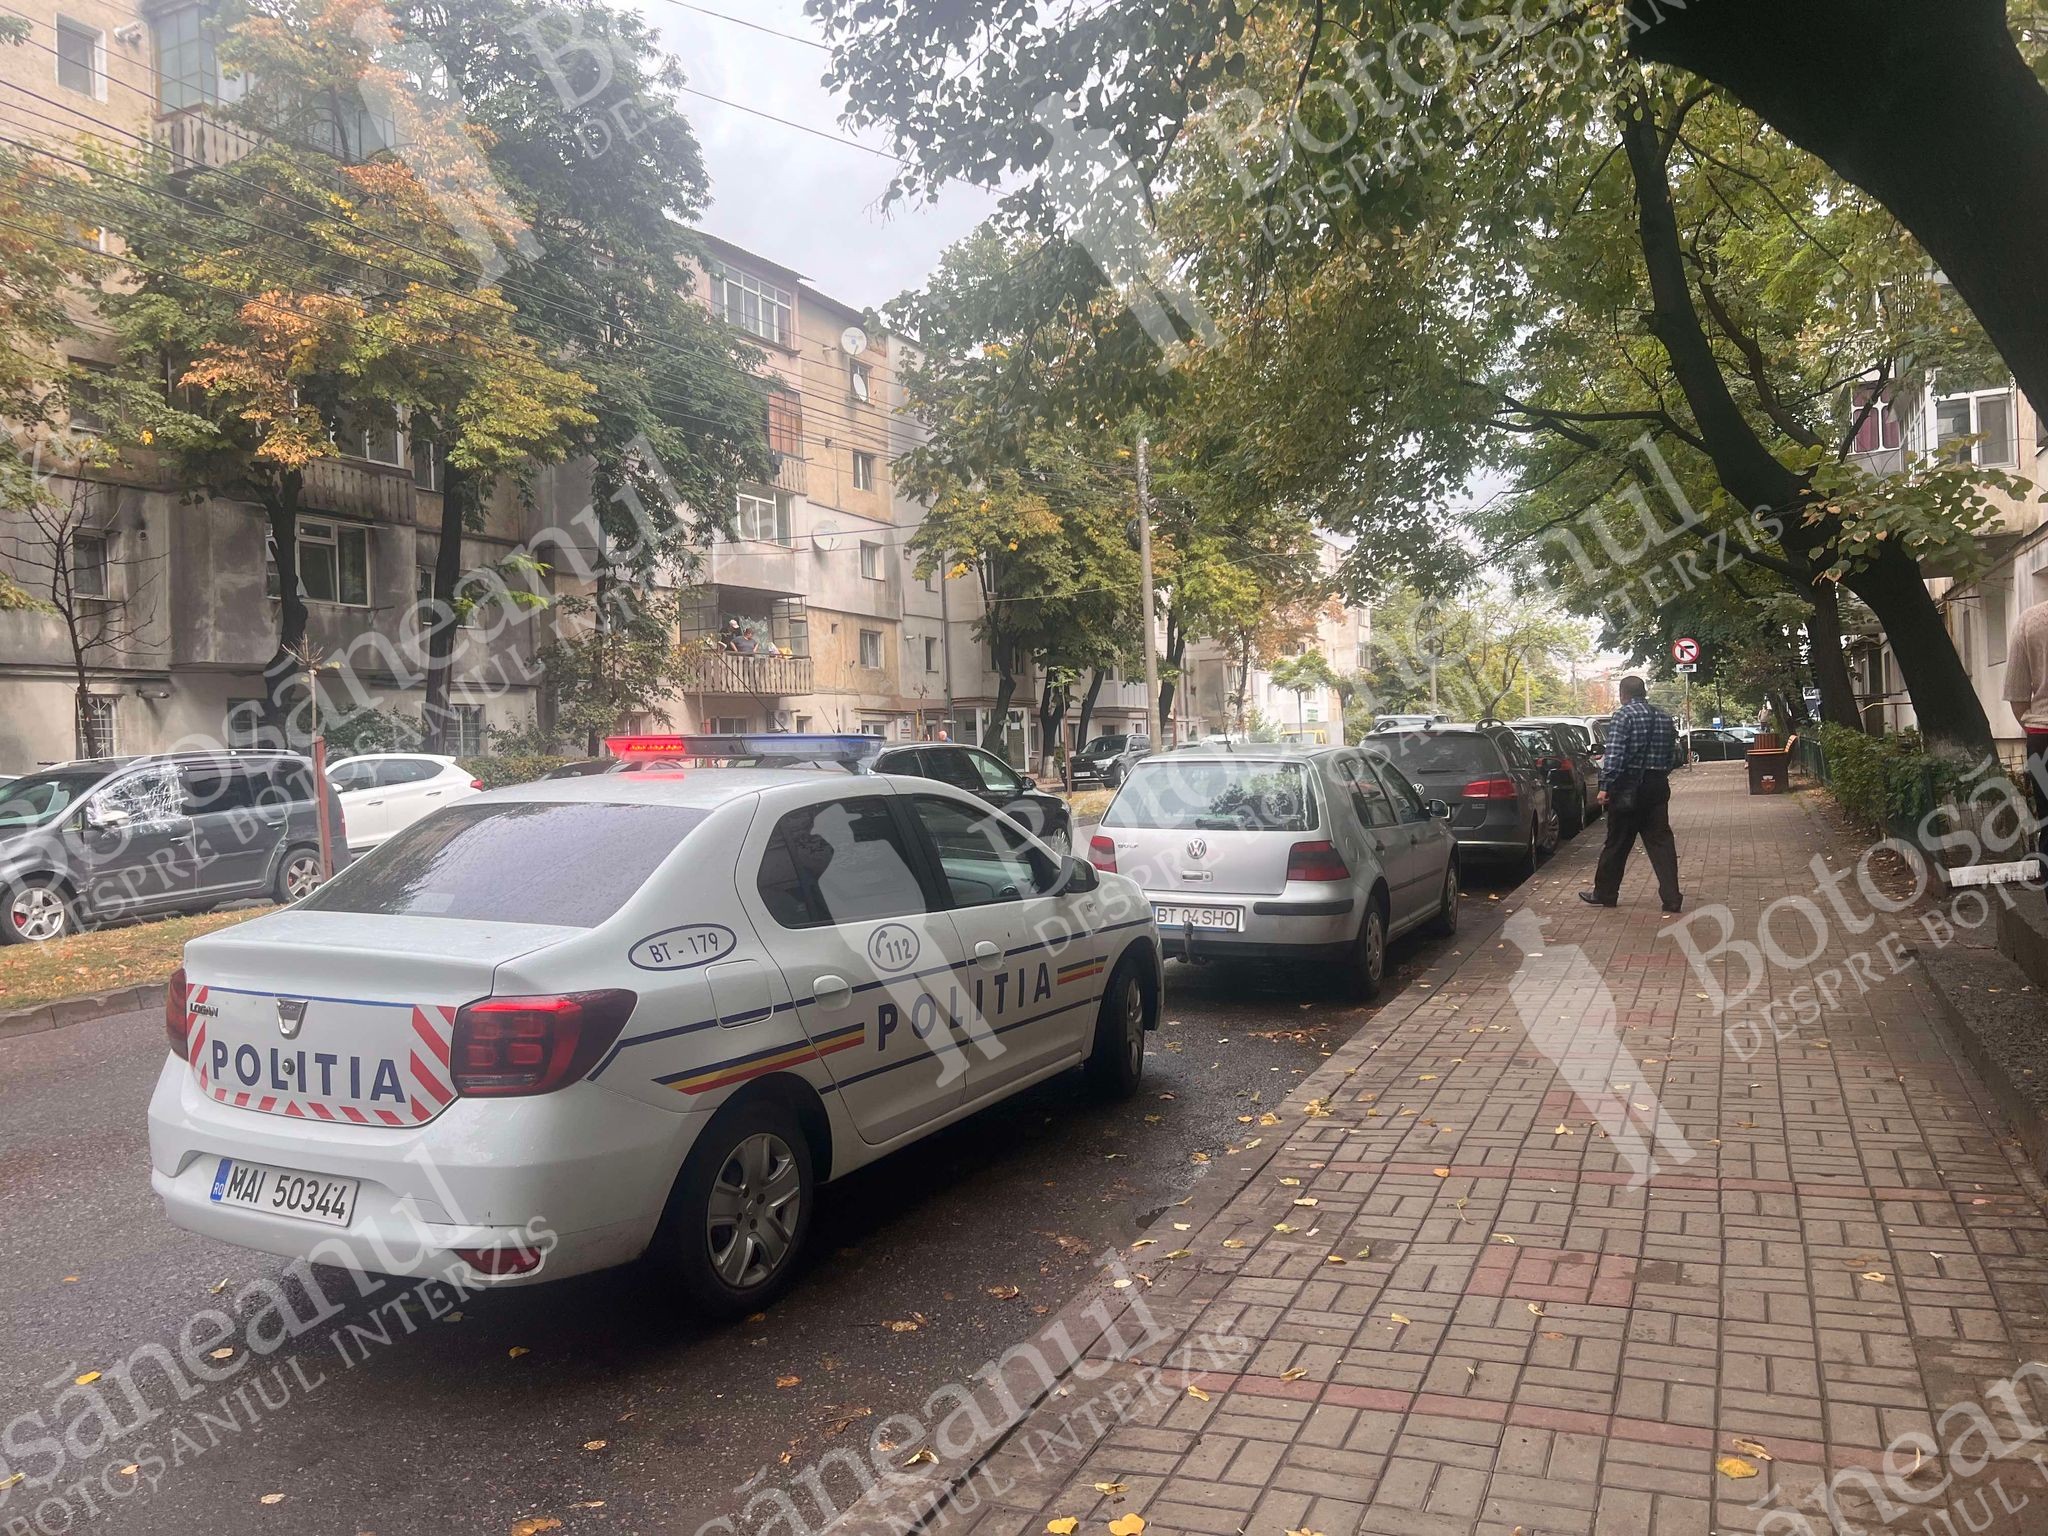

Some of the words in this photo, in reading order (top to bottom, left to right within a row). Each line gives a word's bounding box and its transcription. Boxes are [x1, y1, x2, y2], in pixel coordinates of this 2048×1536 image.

[1157, 908, 1176, 924] BT
[1202, 911, 1235, 927] SHO
[648, 942, 672, 963] BT
[687, 932, 719, 955] 179
[885, 939, 913, 963] 112
[190, 1003, 219, 1018] LOGAN
[878, 962, 1051, 1052] POLITIA
[212, 1039, 406, 1104] POLITIA
[213, 1182, 225, 1196] RO
[226, 1166, 267, 1203] MAI
[272, 1174, 347, 1219] 50344
